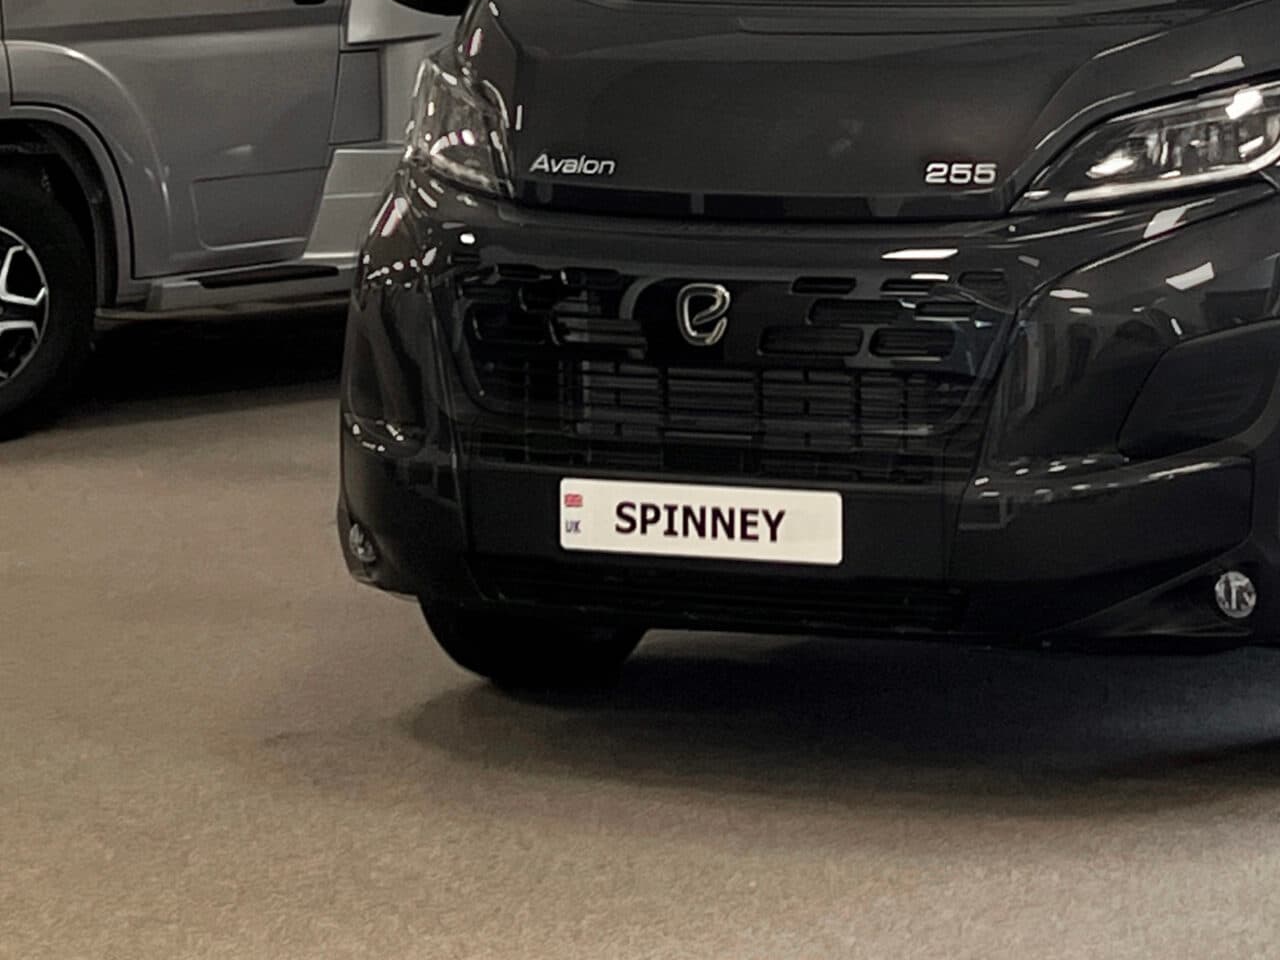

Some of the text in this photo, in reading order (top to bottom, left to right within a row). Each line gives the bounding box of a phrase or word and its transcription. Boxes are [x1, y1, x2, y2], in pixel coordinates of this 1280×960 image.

[529, 153, 616, 175] Avalon
[565, 520, 581, 533] UK
[615, 500, 786, 542] SPINNEY
